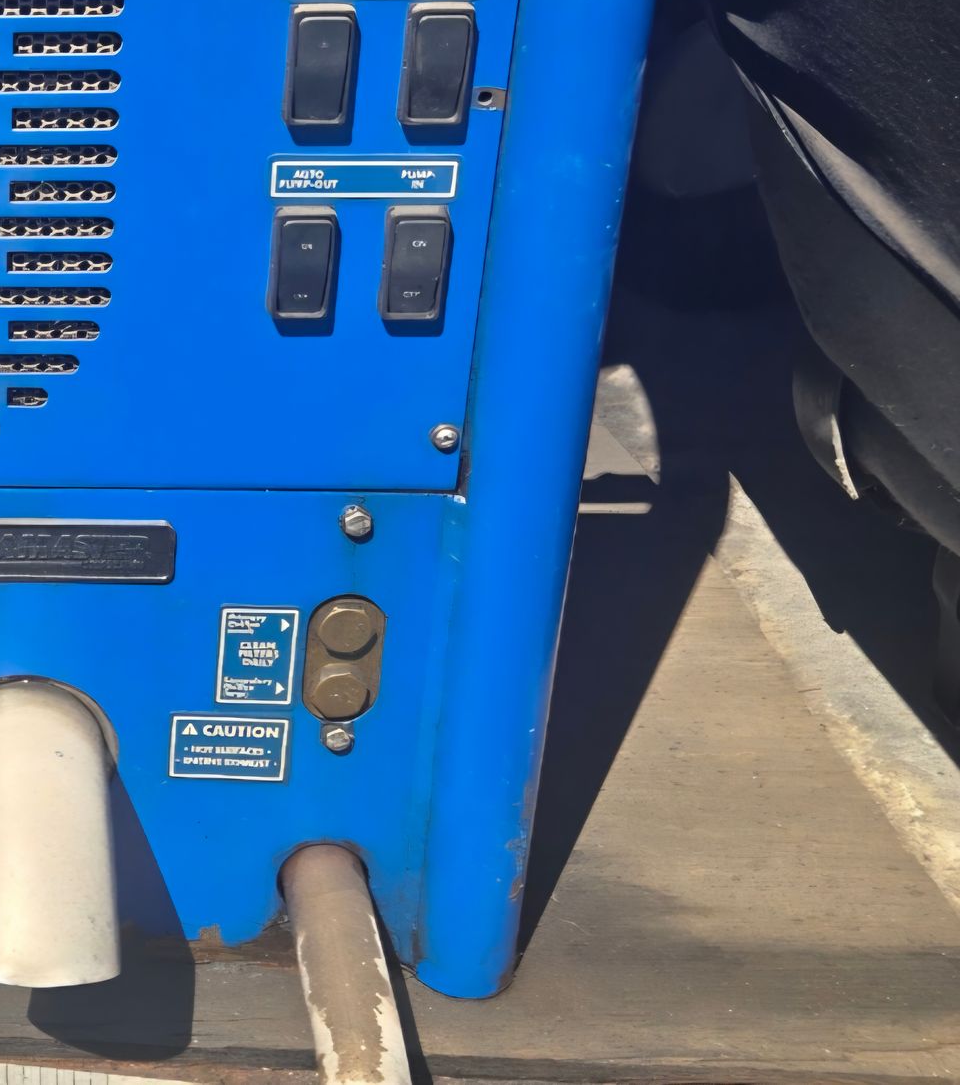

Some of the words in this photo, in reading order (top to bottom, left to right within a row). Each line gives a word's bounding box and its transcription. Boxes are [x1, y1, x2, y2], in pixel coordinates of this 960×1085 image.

[292, 169, 325, 179] AUTO
[401, 169, 436, 179] PUMP
[279, 180, 339, 189] PUMP-OUT
[411, 180, 424, 189] IN
[240, 641, 277, 649] CLEAN
[238, 649, 280, 659] FILTERS
[242, 659, 274, 667] DAILY
[203, 724, 280, 738] CAUTION
[191, 745, 214, 754] HOT
[224, 758, 270, 767] EXHAUST
